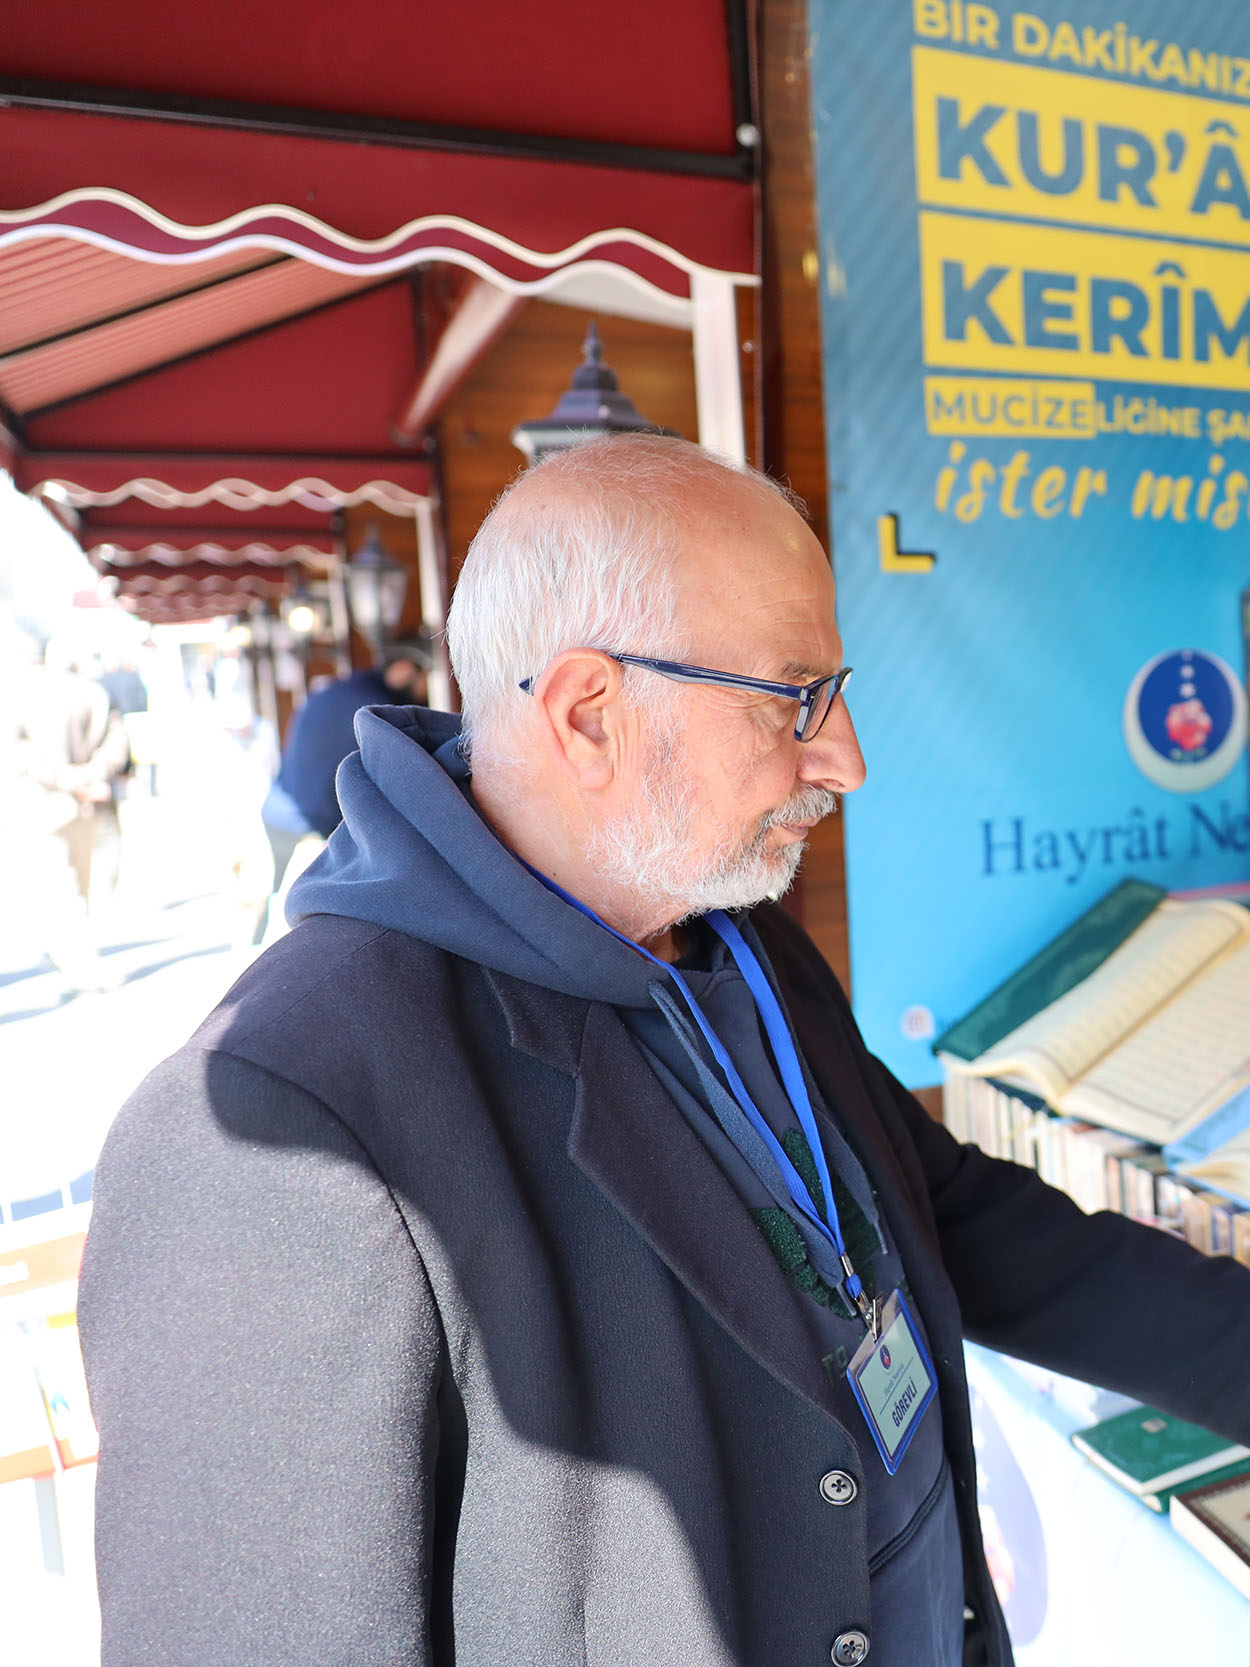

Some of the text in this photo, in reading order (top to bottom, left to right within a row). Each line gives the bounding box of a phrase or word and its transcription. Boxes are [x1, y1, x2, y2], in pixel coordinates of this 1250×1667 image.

[914, 0, 997, 48] BİR
[935, 441, 1107, 523] ister
[980, 806, 1169, 885] Hayrât
[892, 1375, 918, 1428] GÖREVLİ
